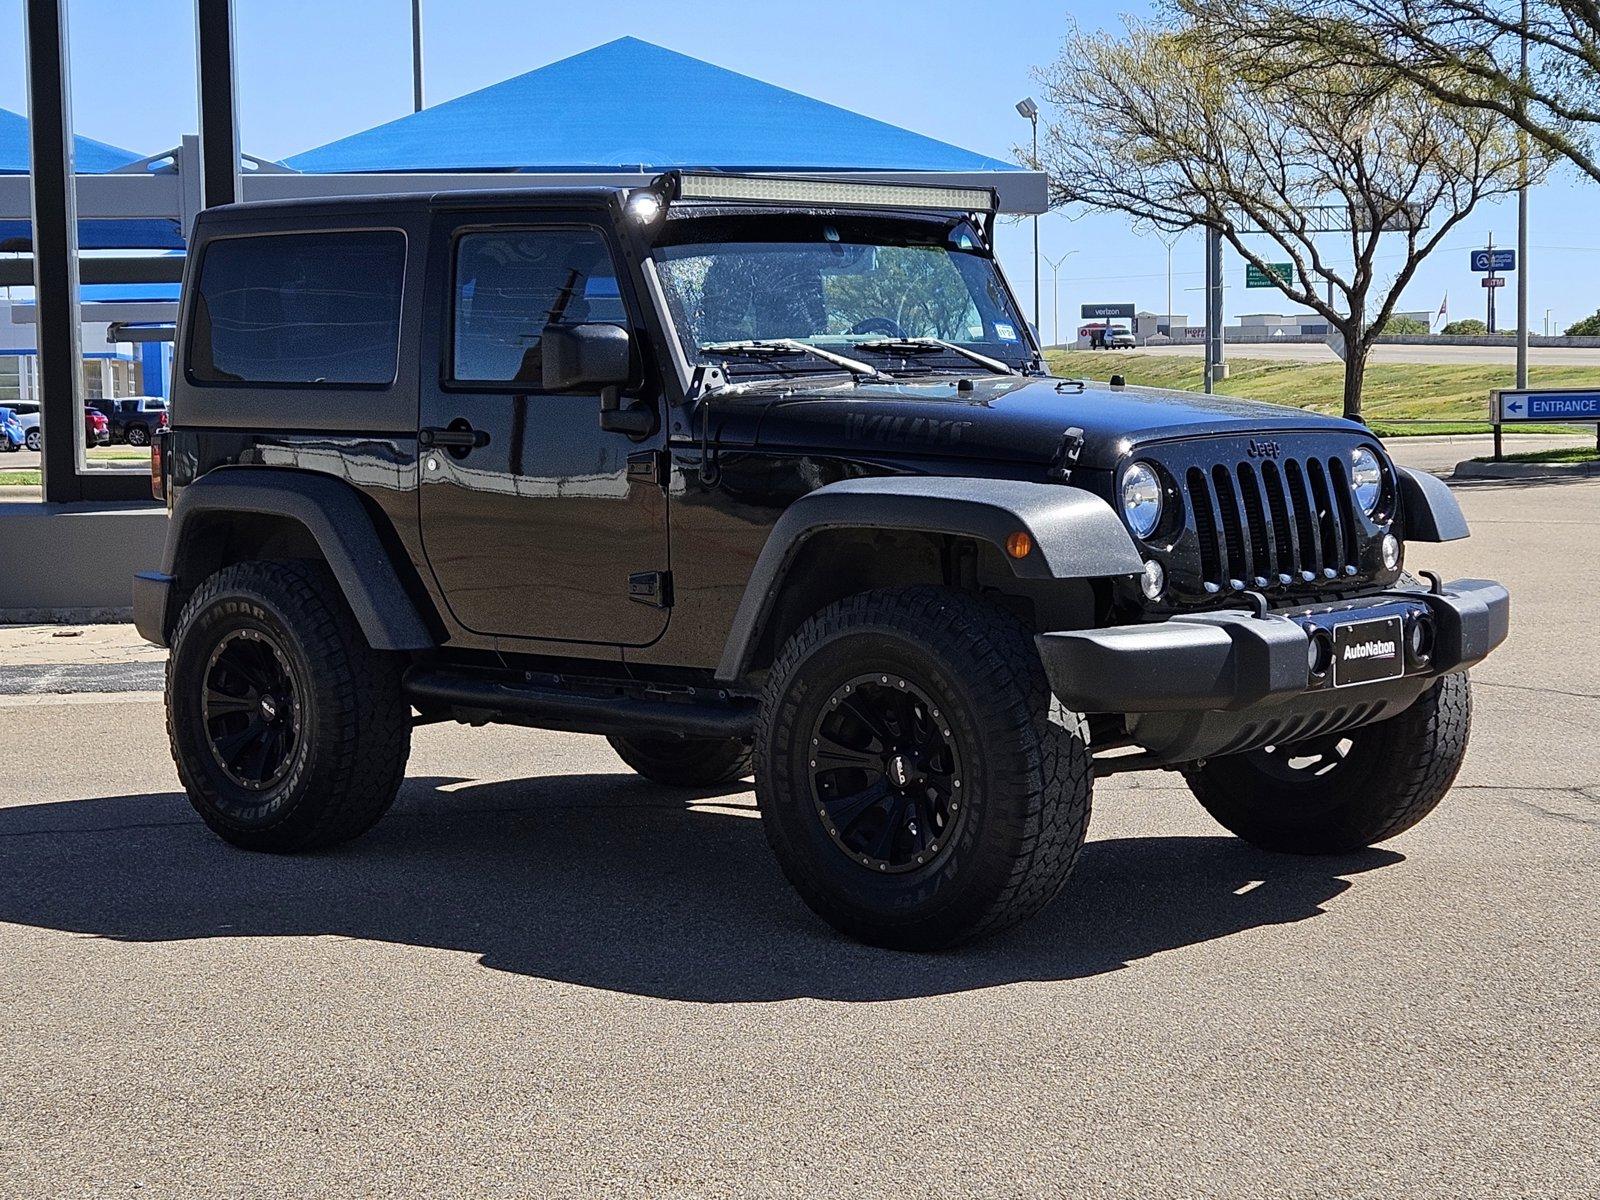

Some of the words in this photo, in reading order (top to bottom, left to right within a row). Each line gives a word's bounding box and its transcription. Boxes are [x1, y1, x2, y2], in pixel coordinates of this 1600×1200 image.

[1095, 307, 1120, 316] verizon
[1533, 400, 1597, 412] ENTRANCE
[1247, 439, 1280, 459] Jeep
[1344, 640, 1396, 661] AutoNation
